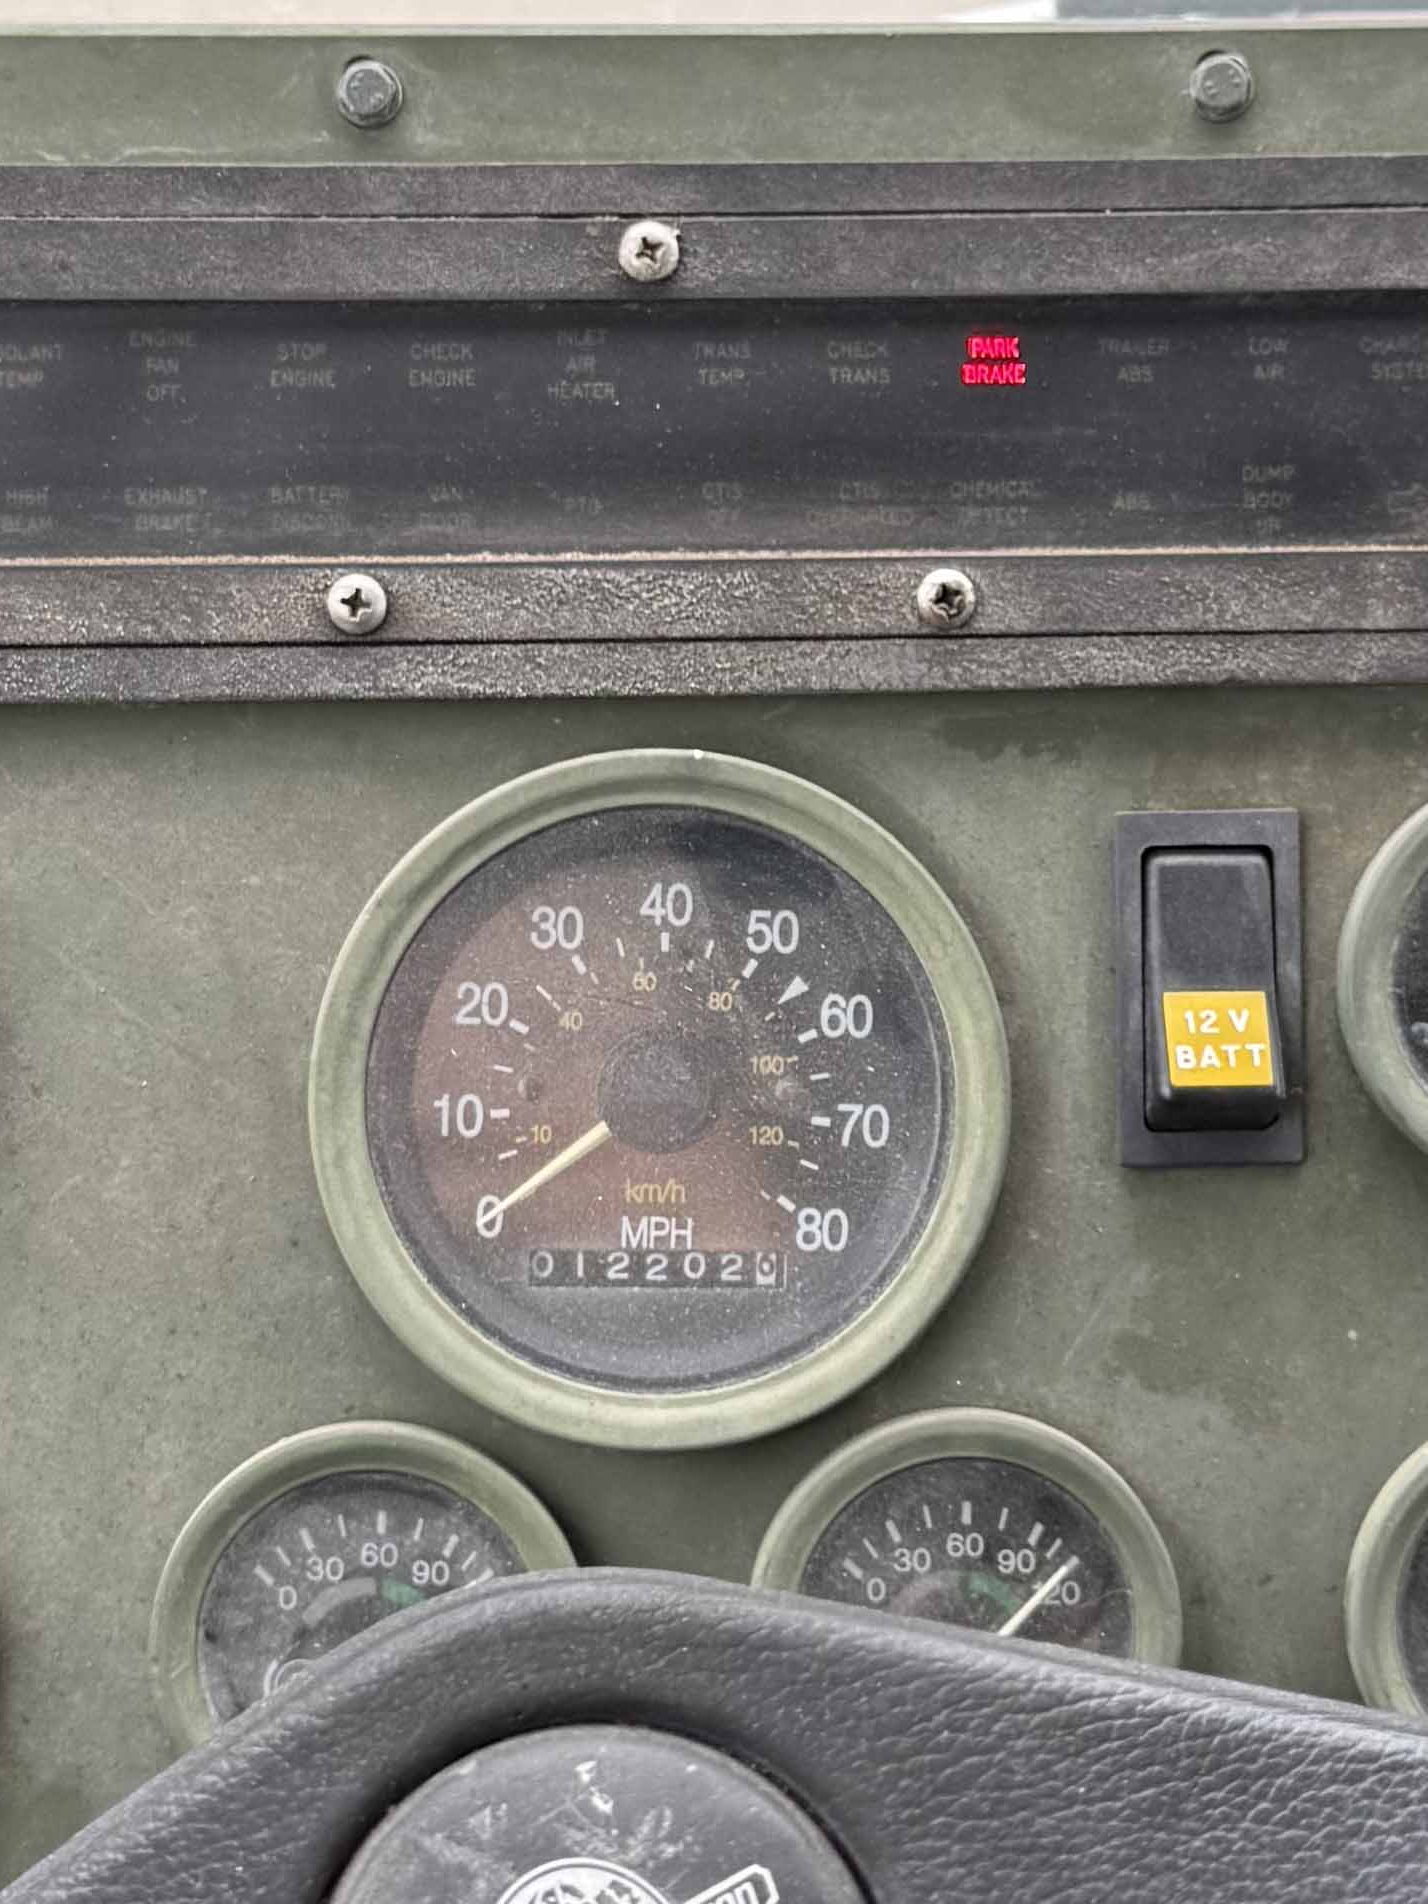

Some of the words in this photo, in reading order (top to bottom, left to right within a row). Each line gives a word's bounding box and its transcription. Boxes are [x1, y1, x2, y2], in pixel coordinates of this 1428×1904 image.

[129, 330, 196, 348] ENGINE
[276, 342, 327, 361] STOP
[409, 342, 474, 361] CHECK
[826, 340, 890, 360] CHECK
[968, 336, 1020, 359] PARK
[271, 368, 337, 389] ENGINE
[407, 368, 477, 388] ENGINE
[828, 366, 891, 386] TRANS
[961, 363, 1026, 385] BRAKE
[1117, 365, 1154, 383] ABS
[547, 381, 616, 400] HEATER
[639, 883, 693, 926] 40
[529, 905, 583, 950] 30
[745, 911, 800, 954] 50
[631, 970, 657, 992] 60
[454, 981, 508, 1027] 20
[708, 989, 734, 1012] 80
[558, 1010, 584, 1031] 40
[819, 993, 873, 1039] 60
[1182, 1009, 1217, 1033] 12
[1229, 1009, 1250, 1032] V
[750, 1055, 785, 1075] 100
[1173, 1042, 1266, 1071] BATT
[433, 1093, 484, 1137] 10
[836, 1103, 890, 1147] 70
[530, 1124, 553, 1144] 10
[749, 1127, 785, 1147] 120
[623, 1178, 687, 1205] km/h
[475, 1194, 504, 1237] 0
[620, 1215, 693, 1250] MPH
[795, 1207, 849, 1251] 80
[360, 1542, 398, 1568] 60
[946, 1532, 984, 1557] 60
[306, 1555, 344, 1581] 30
[411, 1559, 450, 1586] 90
[893, 1547, 931, 1573] 30
[997, 1548, 1036, 1574] 90
[278, 1584, 298, 1610] 0
[865, 1576, 886, 1602] 0
